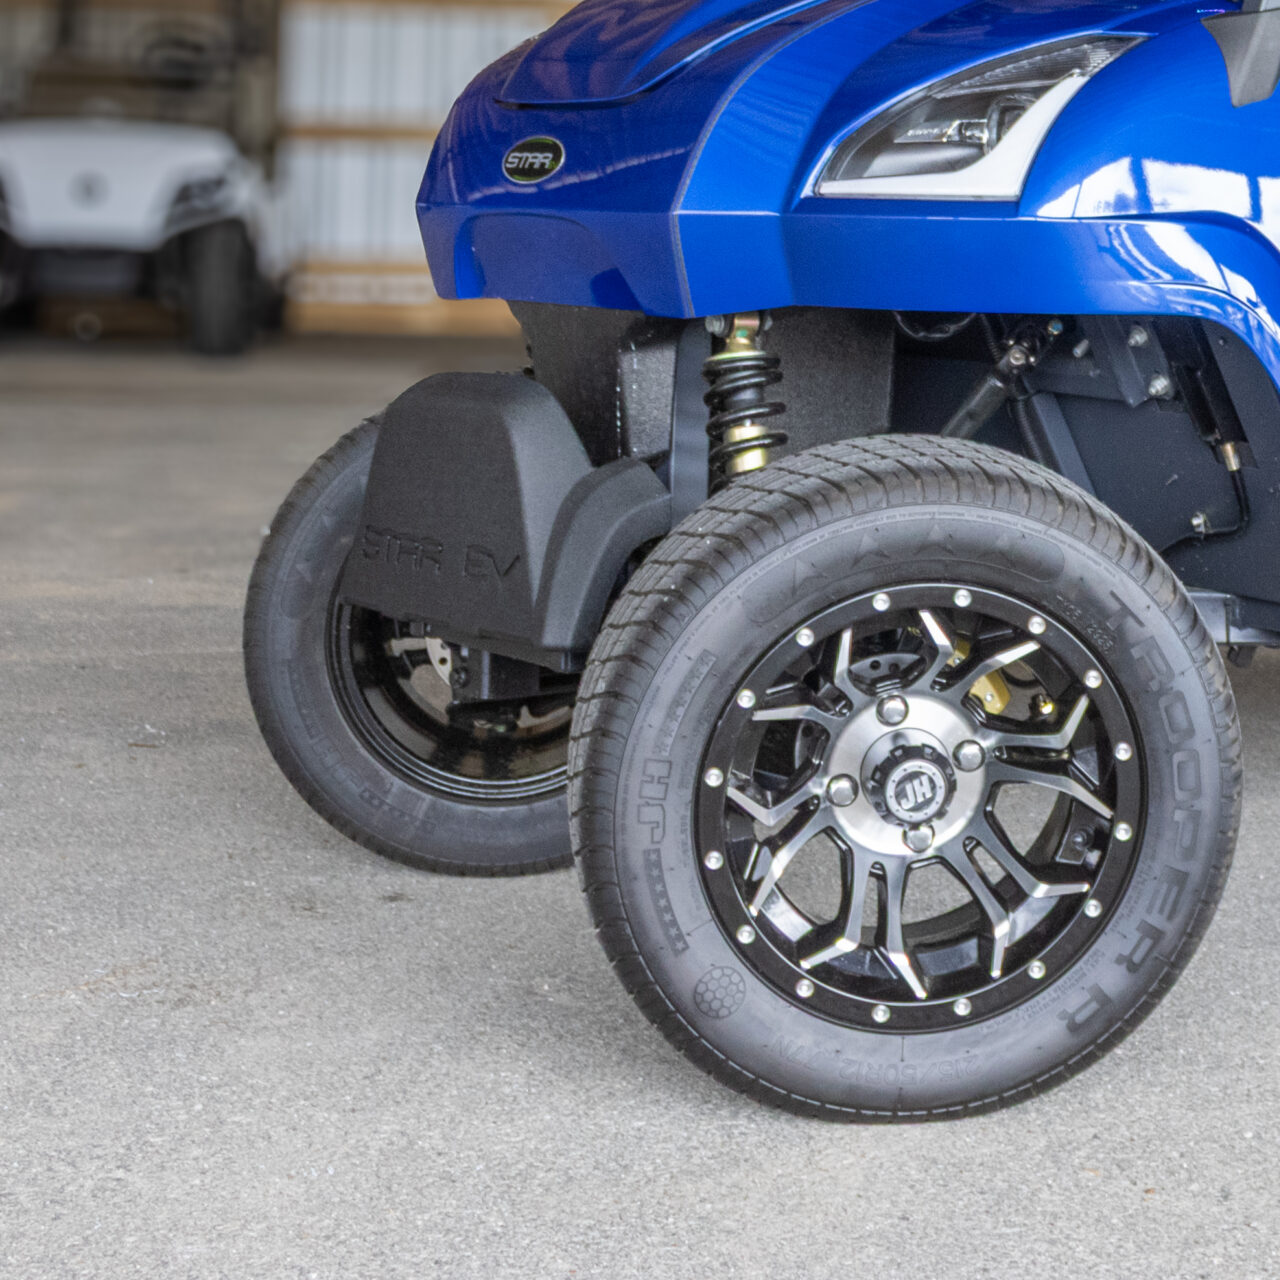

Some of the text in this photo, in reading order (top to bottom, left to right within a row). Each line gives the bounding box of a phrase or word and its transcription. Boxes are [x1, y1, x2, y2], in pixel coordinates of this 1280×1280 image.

[505, 152, 553, 169] STAR
[362, 524, 521, 582] STAR EV
[636, 758, 672, 845] JH
[900, 774, 933, 810] JH
[1106, 589, 1202, 975] TROOPER
[1056, 982, 1116, 1034] R
